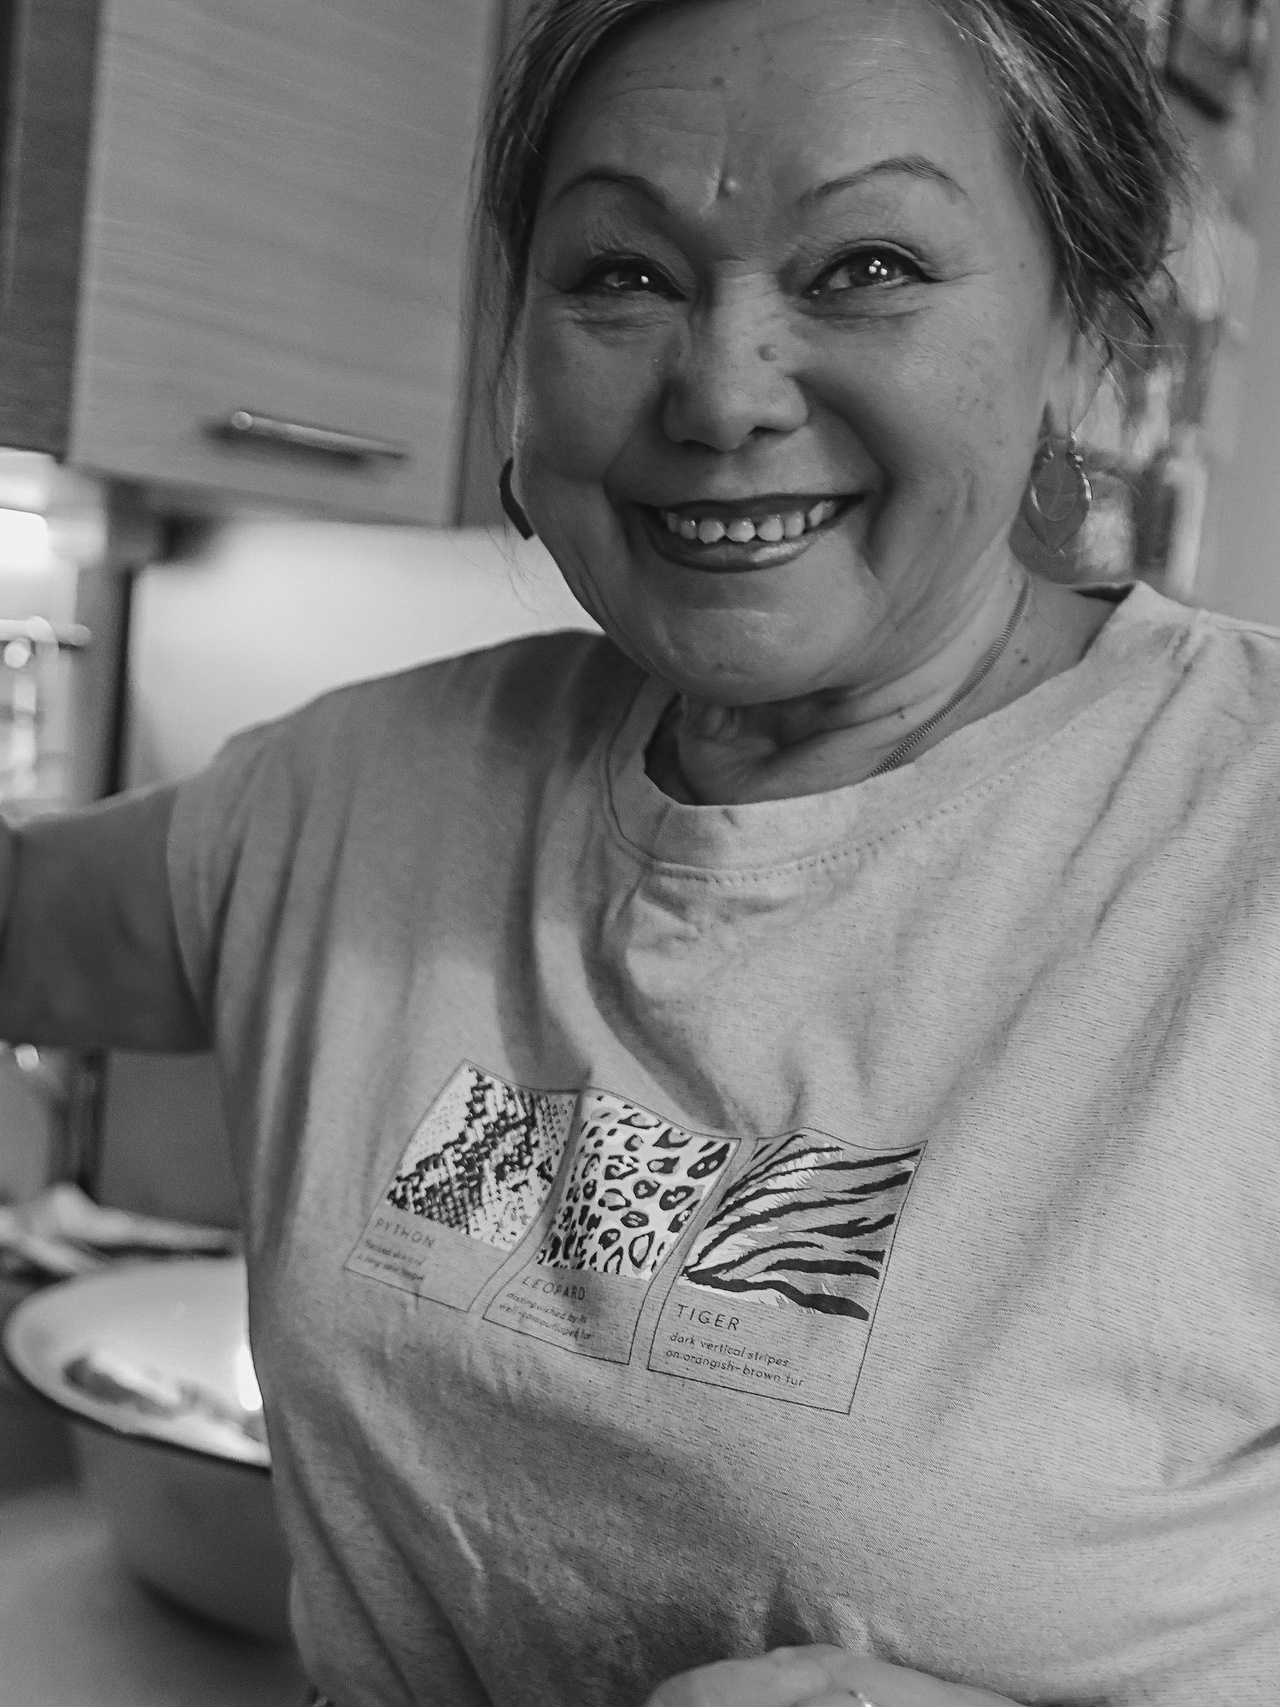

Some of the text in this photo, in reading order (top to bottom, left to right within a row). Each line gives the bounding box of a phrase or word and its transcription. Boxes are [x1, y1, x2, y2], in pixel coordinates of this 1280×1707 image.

[522, 1276, 586, 1301] LEOPARD
[677, 1303, 740, 1331] TIGER
[665, 1348, 680, 1359] on
[668, 1332, 790, 1368] dark vertical stripes
